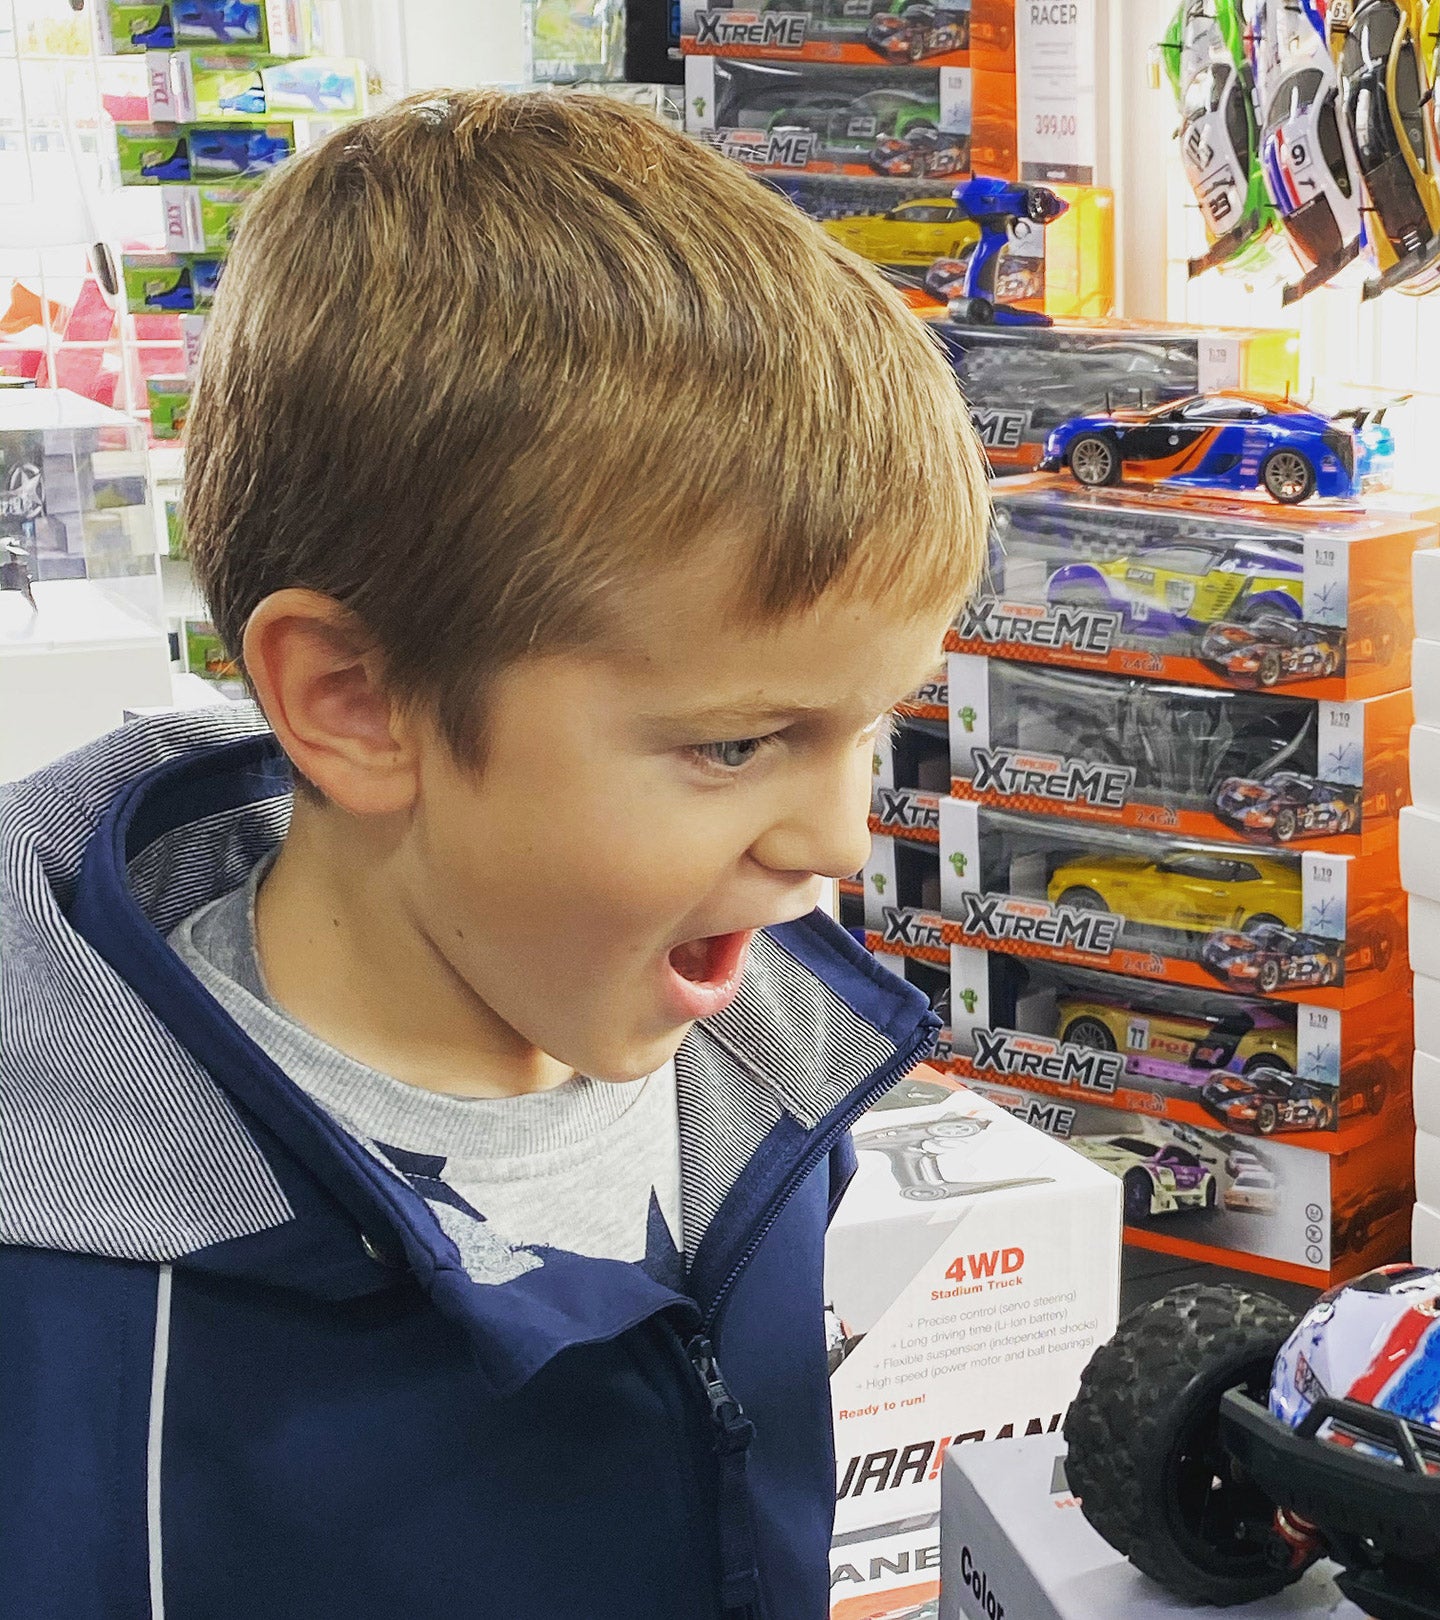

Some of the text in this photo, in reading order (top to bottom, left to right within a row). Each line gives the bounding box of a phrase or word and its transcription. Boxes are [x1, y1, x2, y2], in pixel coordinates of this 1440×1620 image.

[1031, 4, 1077, 25] RACER
[1036, 115, 1076, 139] 399,00
[961, 605, 1111, 651] XTREME
[1330, 710, 1351, 722] 1:10
[976, 754, 1127, 805] XTREME
[882, 793, 939, 827] XTR
[1313, 866, 1333, 876] 1:10
[887, 910, 942, 946] XTR
[966, 898, 1115, 951] XTREME
[1309, 1012, 1329, 1024] 1:10
[975, 1034, 1118, 1089] XTREME
[945, 1246, 1025, 1283] 4WD
[930, 1276, 1023, 1301] Stadium Truck
[917, 1288, 1077, 1329] Precise control (servo steering)
[883, 1317, 1098, 1370] Flexible suspension (independent shocks)
[900, 1335, 929, 1351] Long
[931, 1326, 966, 1344] driving
[969, 1322, 992, 1336] time
[1029, 1308, 1068, 1326] battery)
[866, 1335, 1094, 1391] High speed (power motor and ball bearings)
[838, 1393, 926, 1422] Ready to run!
